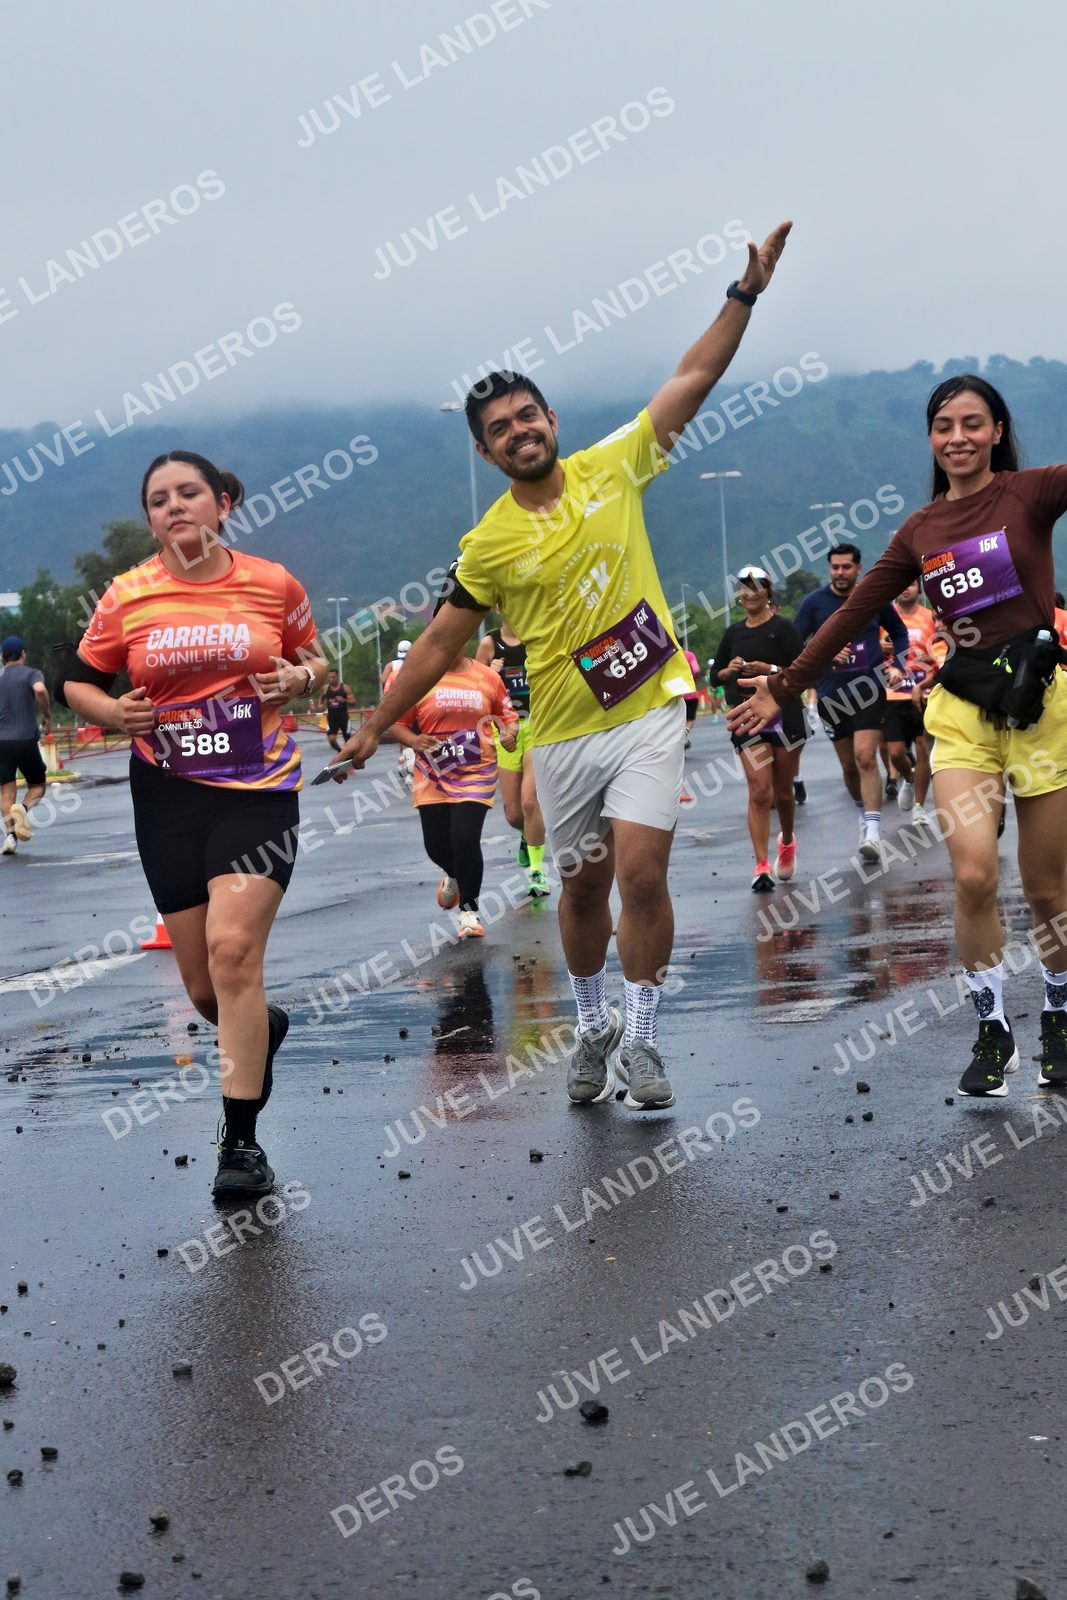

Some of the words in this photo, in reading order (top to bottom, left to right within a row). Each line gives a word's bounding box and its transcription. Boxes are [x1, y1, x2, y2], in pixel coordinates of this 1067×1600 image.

[940, 568, 984, 599] 638
[633, 608, 649, 628] 15K
[146, 624, 250, 651] CARRERA
[146, 648, 226, 668] OMNILIFE
[610, 642, 648, 679] 639
[436, 688, 482, 701] CARRERA
[160, 706, 203, 724] CARRERA
[158, 720, 193, 732] OMNILIFE
[181, 732, 230, 757] 588
[442, 744, 465, 756] 413
